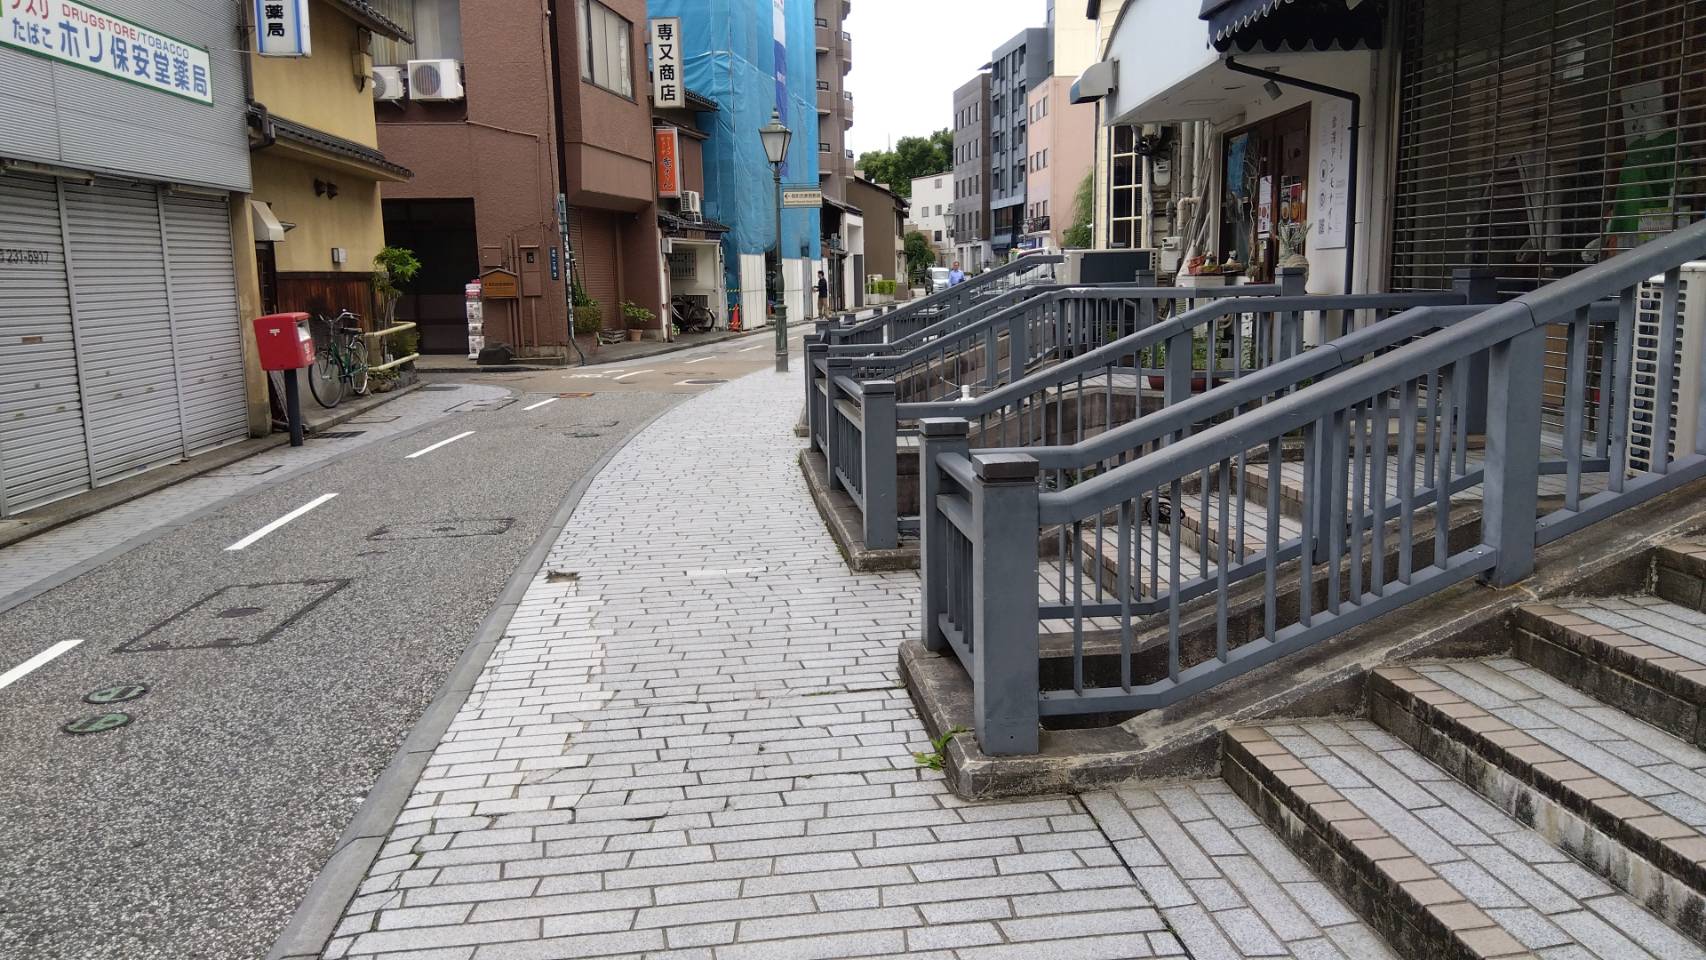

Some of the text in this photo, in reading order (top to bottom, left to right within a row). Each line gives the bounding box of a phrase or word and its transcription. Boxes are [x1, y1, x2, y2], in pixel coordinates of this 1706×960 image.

[12, 17, 53, 49] たばこ
[265, 0, 285, 37] 薬局
[657, 23, 676, 101] 専又商店
